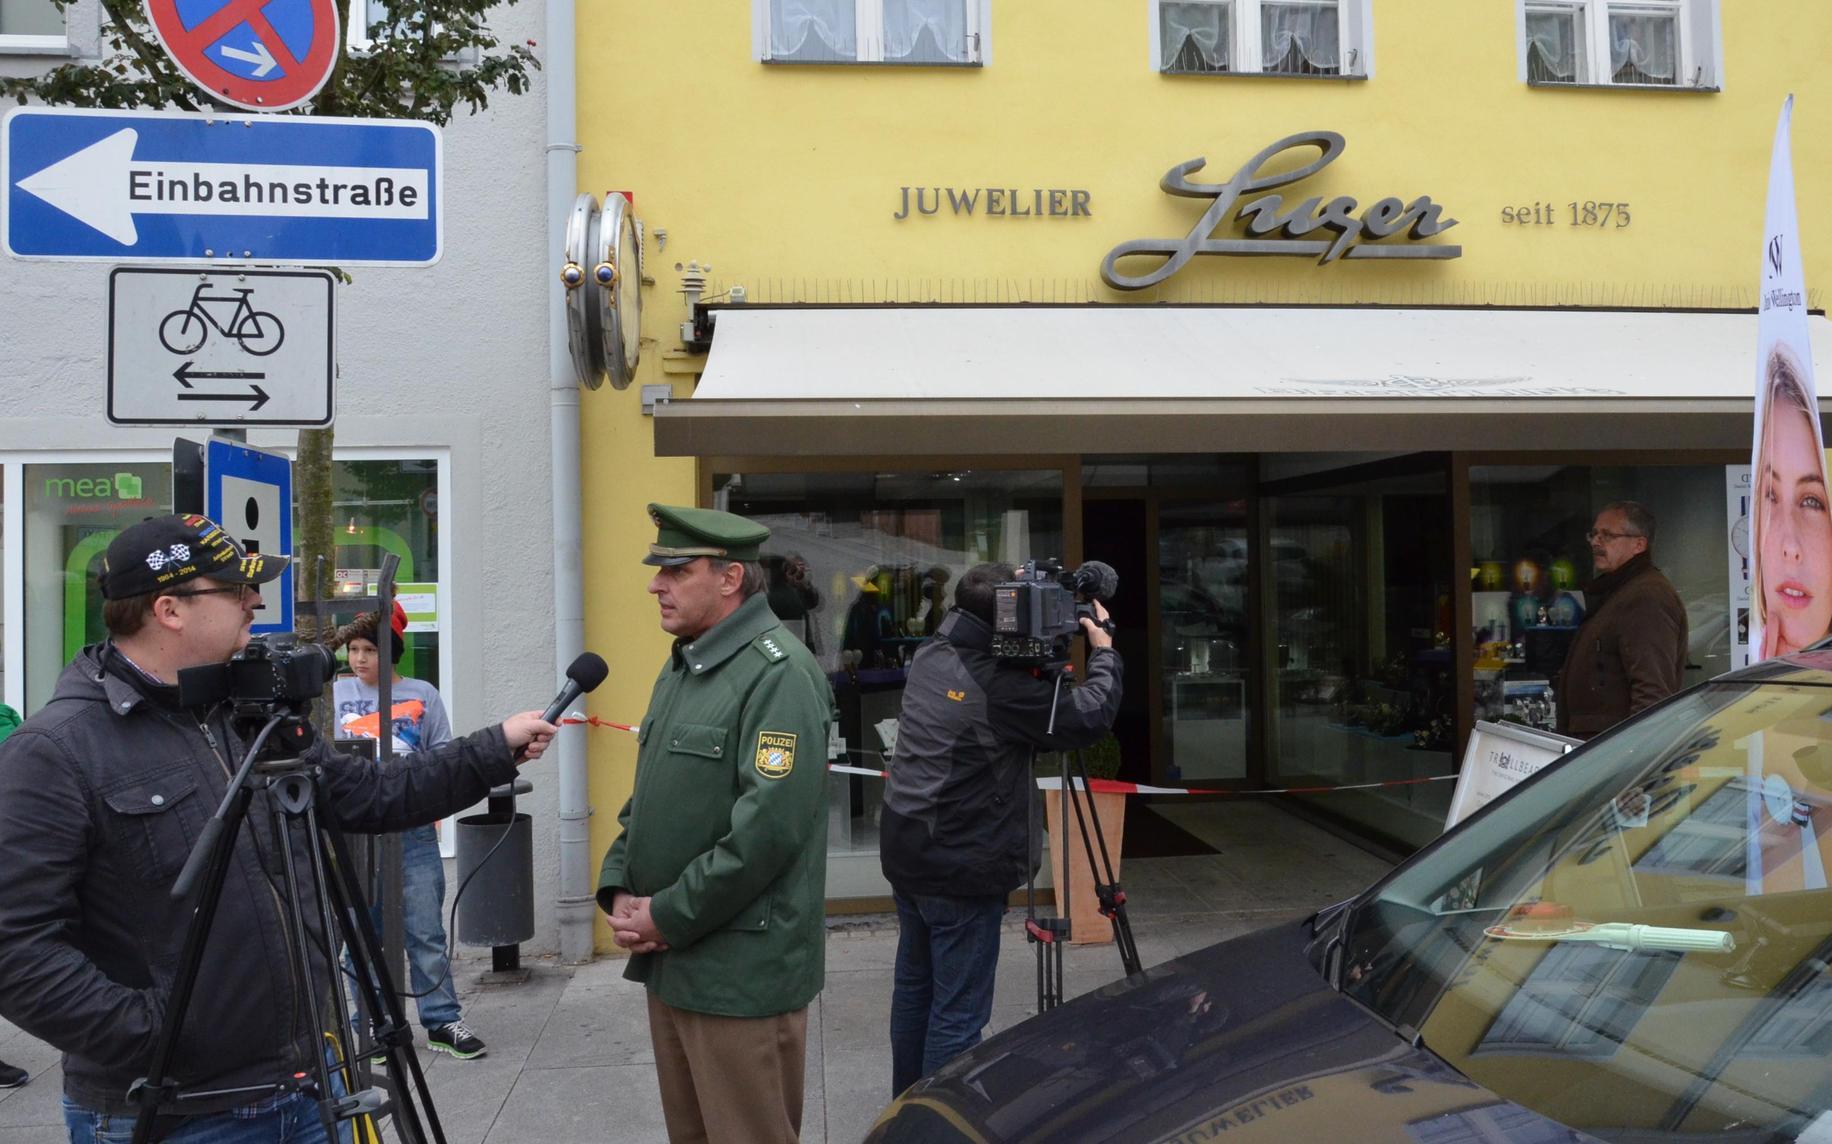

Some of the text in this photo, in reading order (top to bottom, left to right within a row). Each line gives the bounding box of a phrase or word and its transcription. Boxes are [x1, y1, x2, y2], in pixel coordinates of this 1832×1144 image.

[129, 170, 418, 207] Einbahnstraße
[893, 187, 1092, 220] JUWELIER
[1501, 200, 1631, 228] seit 1875
[45, 478, 112, 497] mea
[761, 736, 793, 748] POLIZEI
